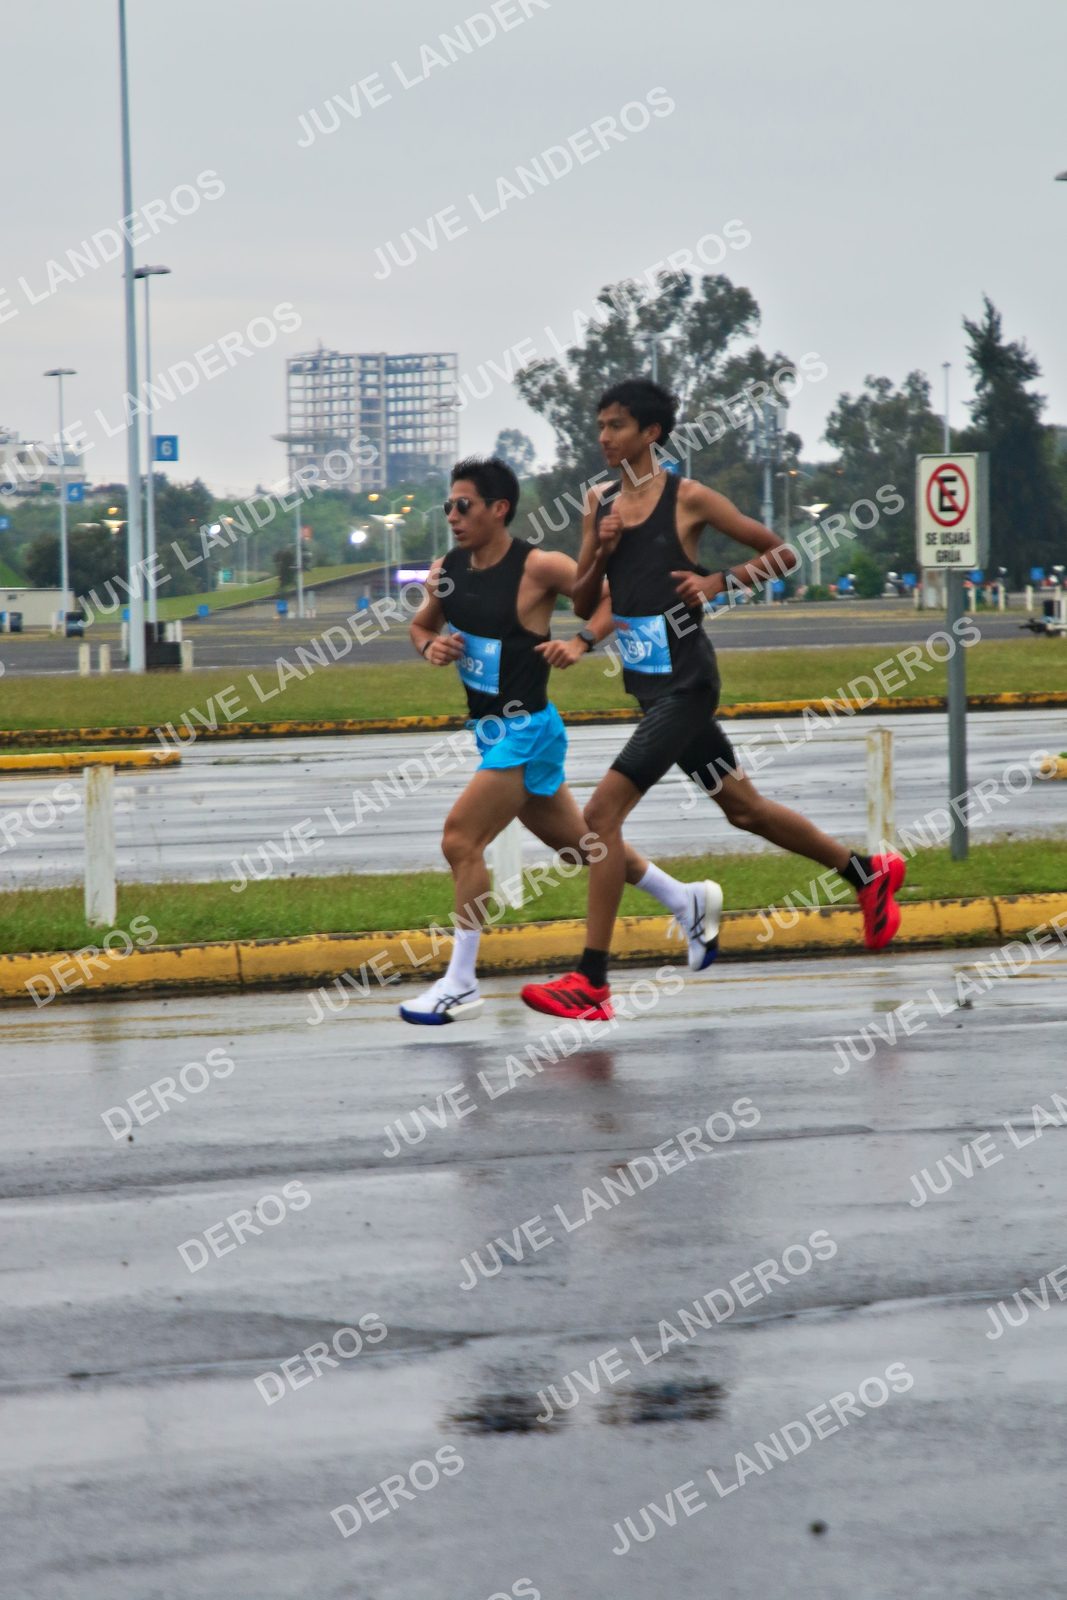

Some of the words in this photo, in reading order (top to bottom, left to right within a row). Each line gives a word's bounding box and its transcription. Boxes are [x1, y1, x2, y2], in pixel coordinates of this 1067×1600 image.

[161, 441, 173, 456] 6
[69, 488, 79, 497] 4
[926, 532, 937, 545] SE
[941, 528, 971, 544] USARÁ
[936, 546, 961, 562] GRÚA
